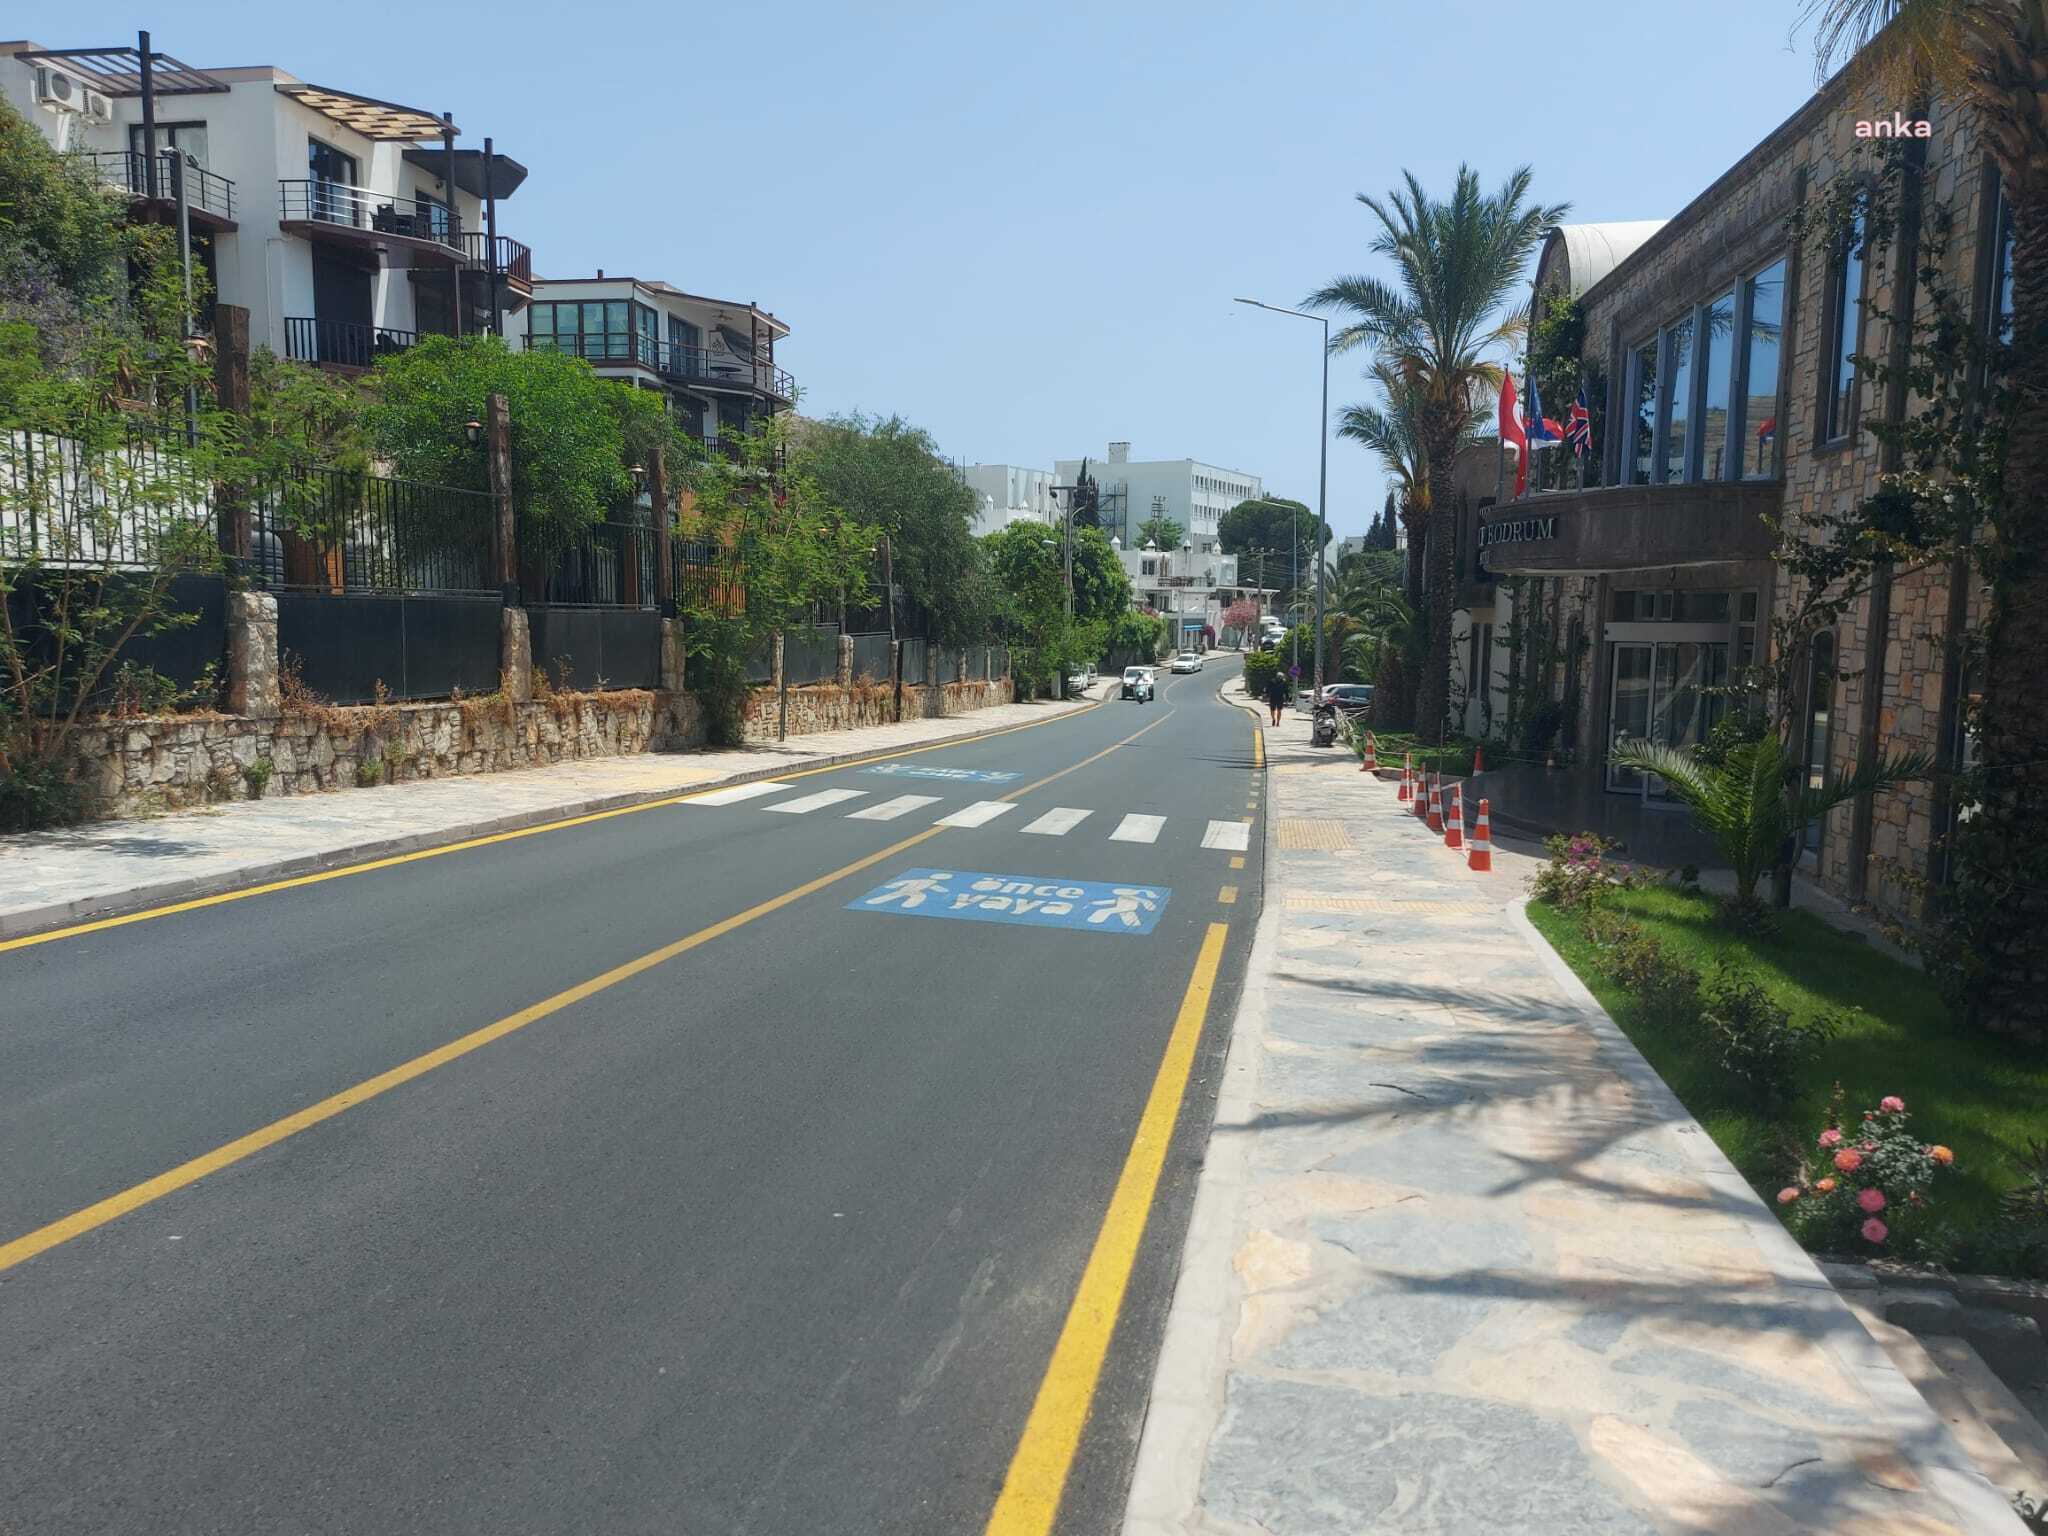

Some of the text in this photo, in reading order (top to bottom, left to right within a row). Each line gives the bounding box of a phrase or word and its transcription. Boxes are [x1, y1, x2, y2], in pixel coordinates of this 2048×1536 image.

[1488, 518, 1554, 545] BODRUM
[971, 877, 1084, 898] önce
[948, 892, 1074, 915] yaya
